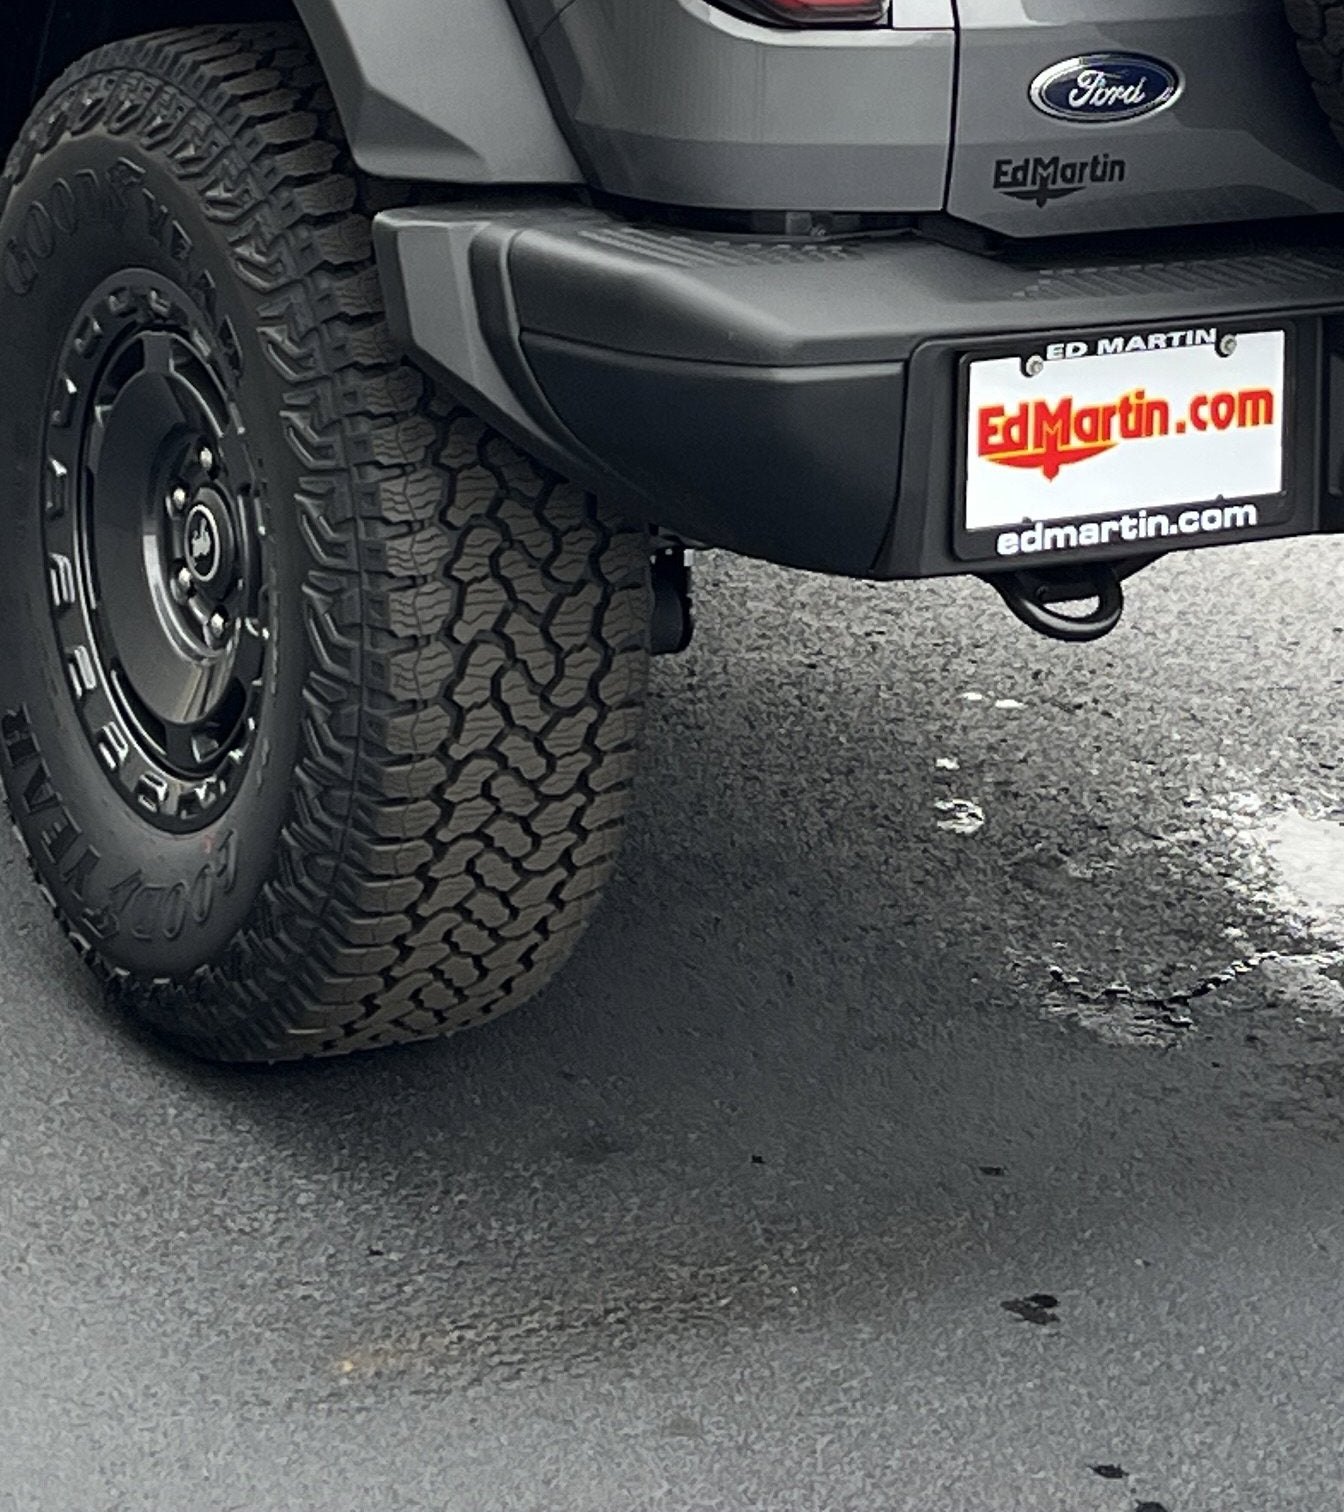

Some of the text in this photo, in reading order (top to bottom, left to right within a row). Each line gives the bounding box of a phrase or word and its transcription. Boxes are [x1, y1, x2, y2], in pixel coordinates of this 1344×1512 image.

[1068, 67, 1148, 109] Ford
[992, 153, 1127, 191] EdMartin
[1045, 328, 1218, 361] ED MARTIN
[996, 502, 1258, 556] edmartin.com
